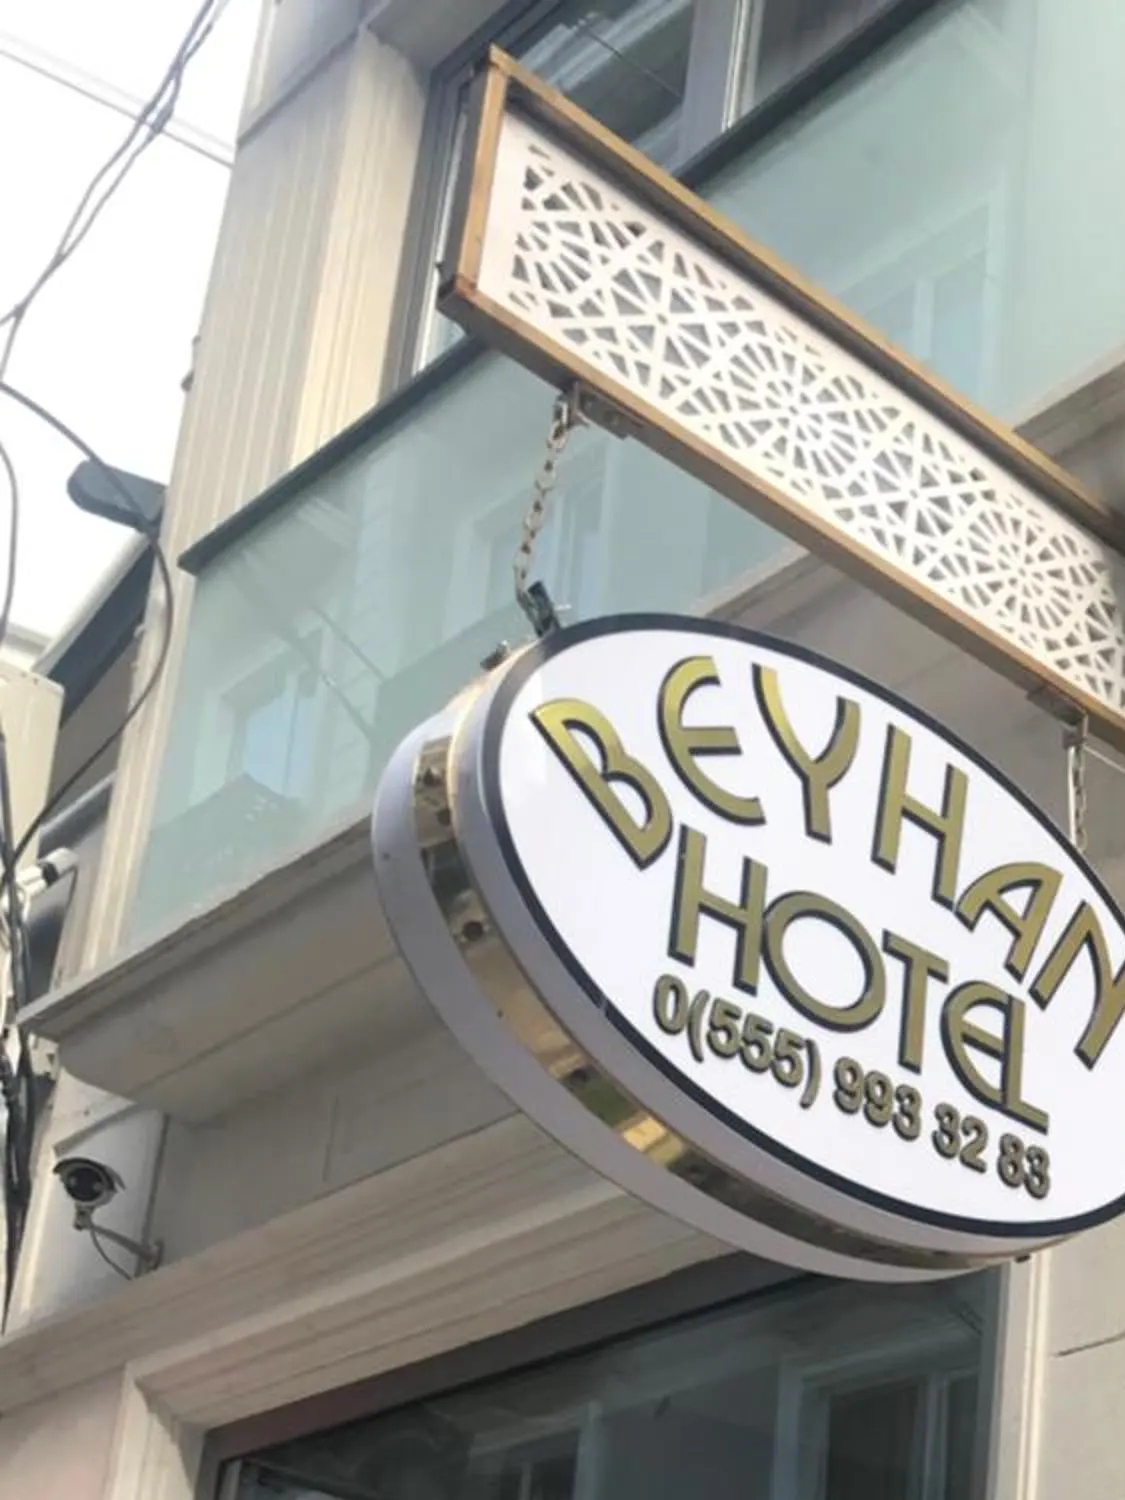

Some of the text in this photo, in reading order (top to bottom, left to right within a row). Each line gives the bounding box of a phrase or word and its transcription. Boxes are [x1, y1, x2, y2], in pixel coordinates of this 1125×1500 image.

[653, 974, 1050, 1199] 0(555) 993 32 83
[667, 824, 1049, 1133] HOTEL
